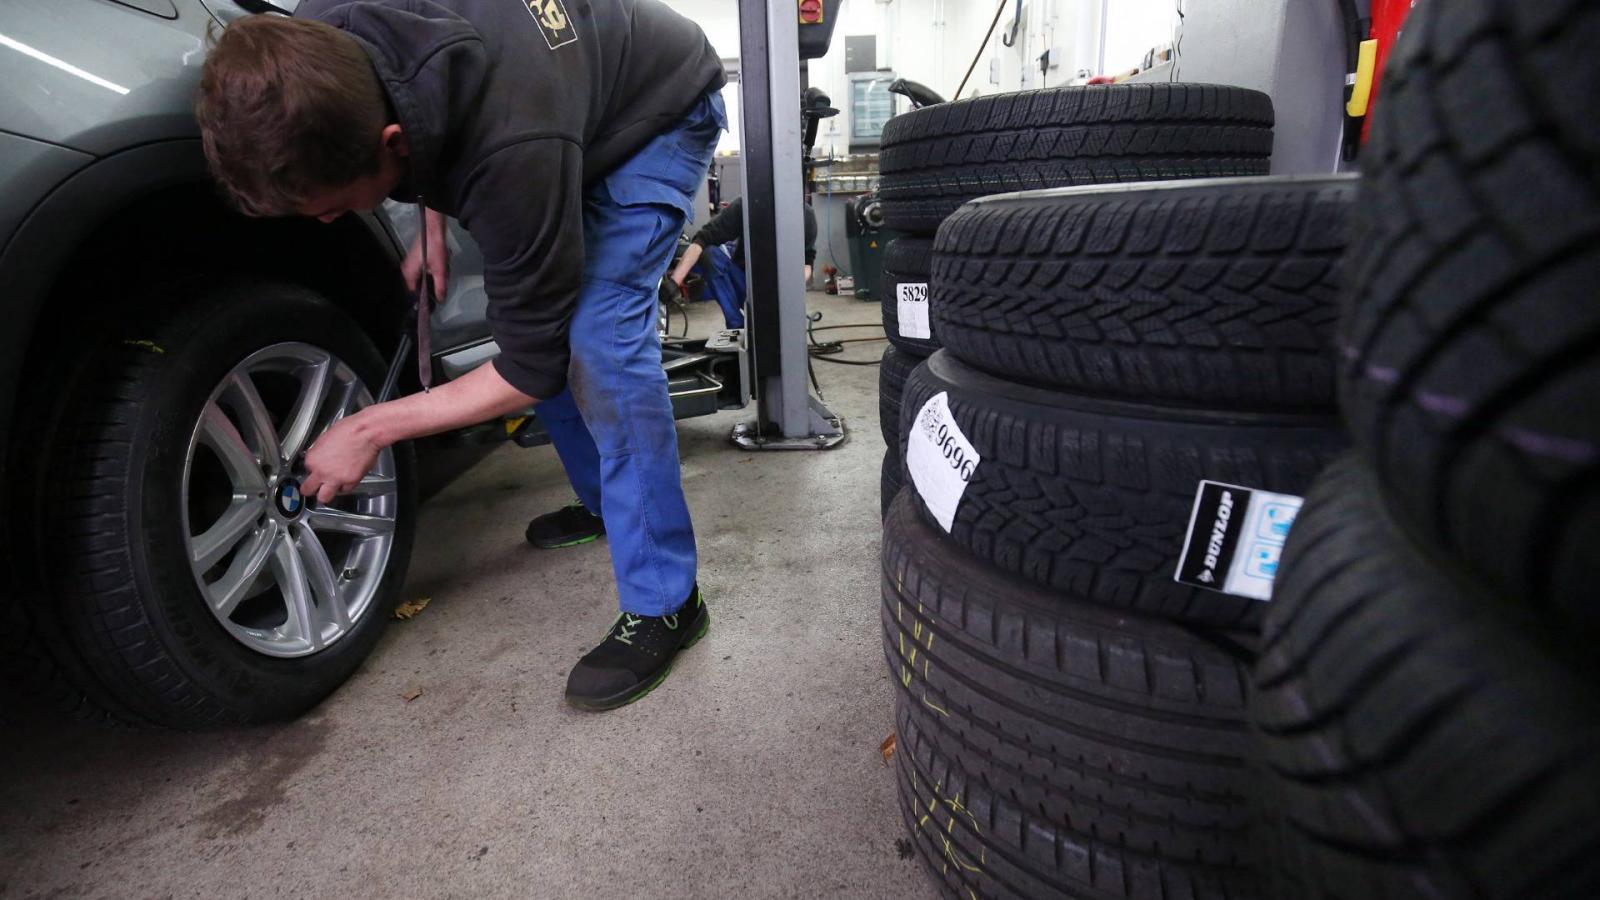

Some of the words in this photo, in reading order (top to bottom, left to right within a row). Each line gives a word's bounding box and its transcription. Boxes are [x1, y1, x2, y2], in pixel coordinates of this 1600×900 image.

[902, 285, 928, 302] 5829
[935, 424, 976, 482] 9696
[1203, 490, 1234, 570] DUNLOP
